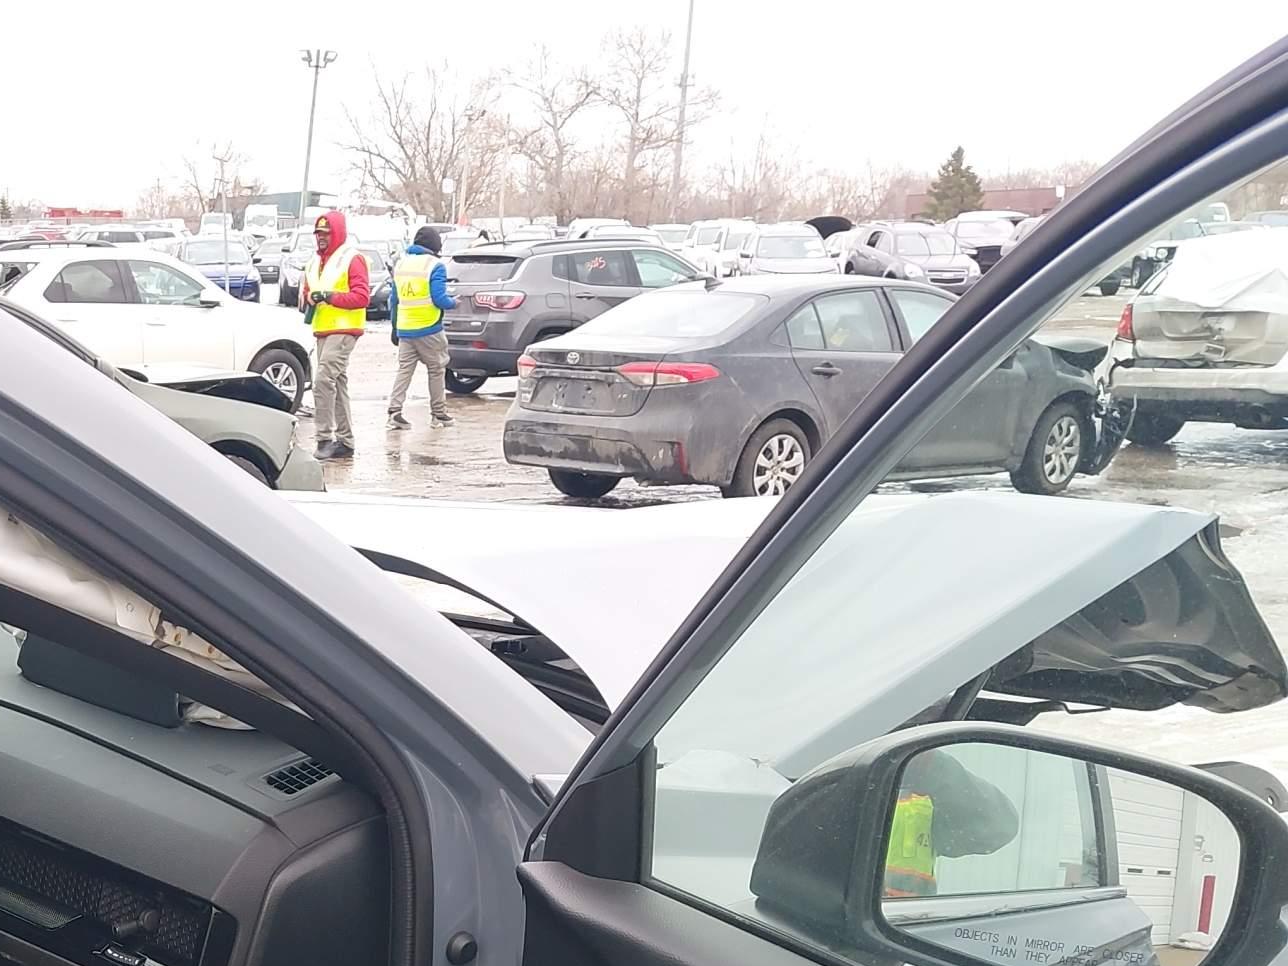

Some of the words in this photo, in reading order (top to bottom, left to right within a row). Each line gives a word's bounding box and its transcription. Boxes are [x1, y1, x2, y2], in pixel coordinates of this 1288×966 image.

[954, 927, 999, 942] OBJECTS
[1007, 935, 1017, 945] IN
[1024, 938, 1065, 953] MIRROR
[1073, 944, 1095, 957] ARE
[1102, 948, 1145, 963] CLOSER
[990, 945, 1017, 959] THAN
[1024, 950, 1051, 964] THEY
